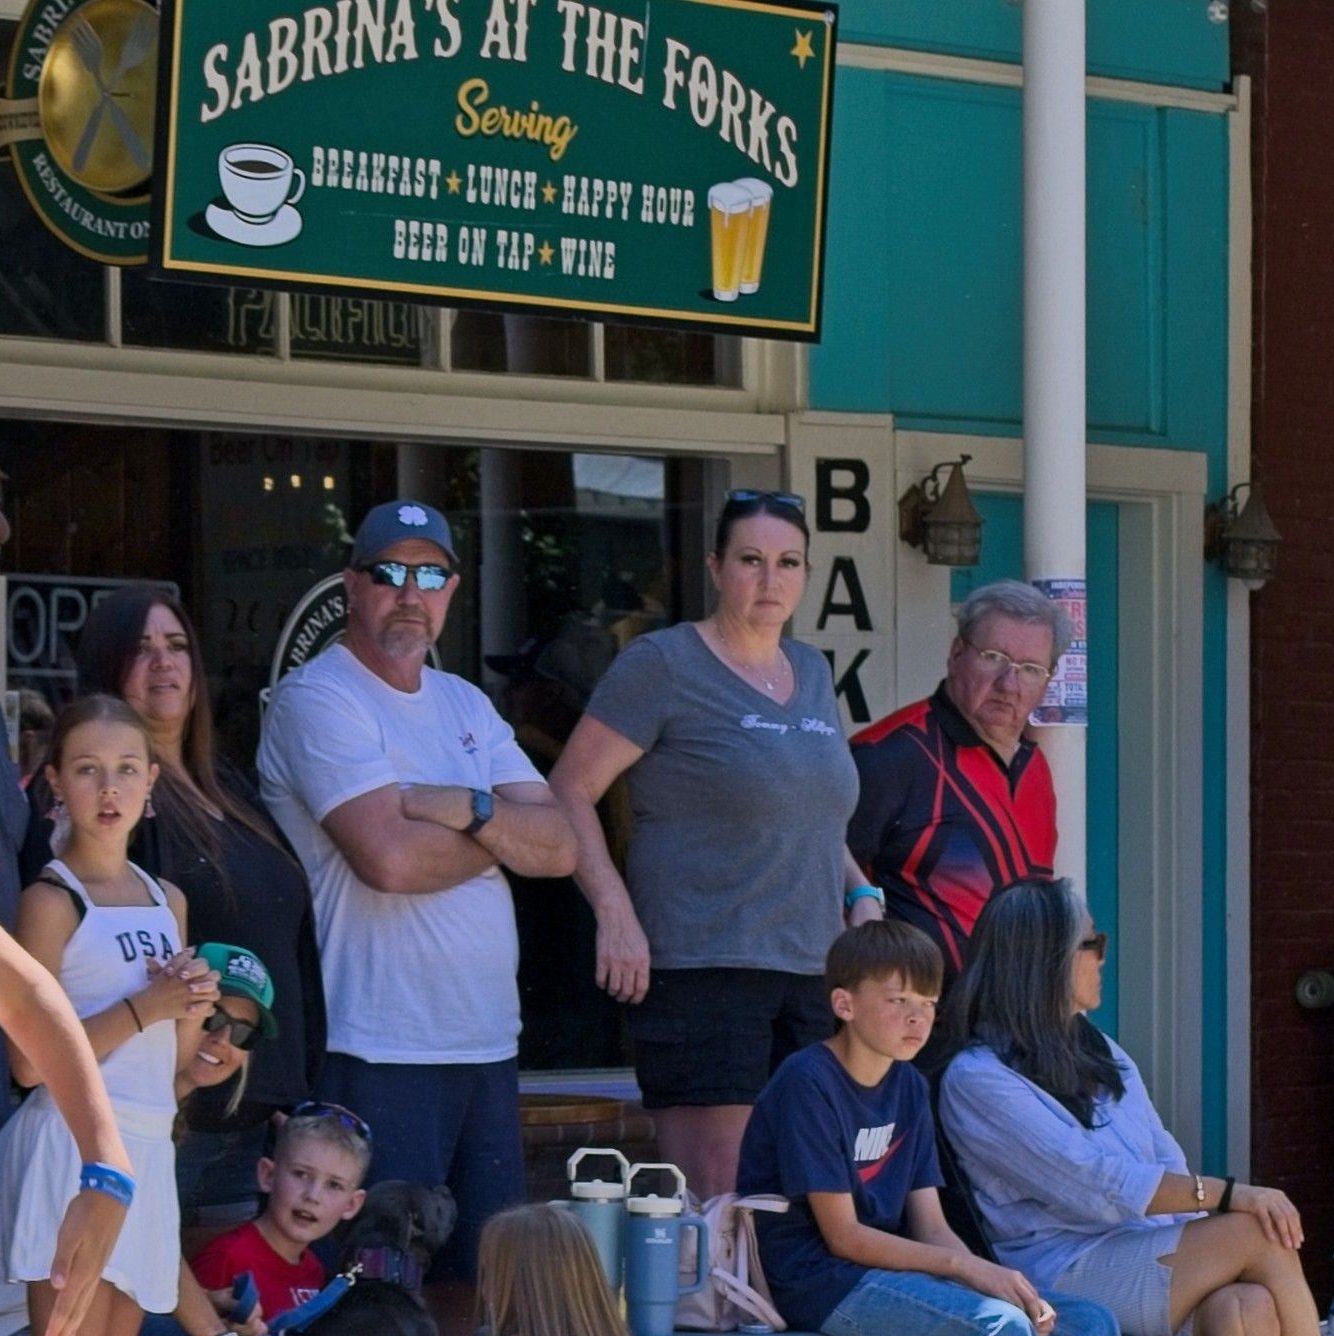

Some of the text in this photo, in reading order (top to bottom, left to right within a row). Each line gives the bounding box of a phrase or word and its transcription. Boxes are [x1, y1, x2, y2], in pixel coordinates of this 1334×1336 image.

[200, 0, 799, 188] SABRINA'S AT THE FORKS
[455, 78, 579, 161] Serving
[32, 152, 127, 238] RESTAURANT
[312, 146, 696, 227] BREAKFAST LUNCH HAPPY HOUR
[394, 220, 617, 280] BEER ON TAP WINE
[287, 596, 345, 672] BRINA'S
[116, 929, 174, 962] USA
